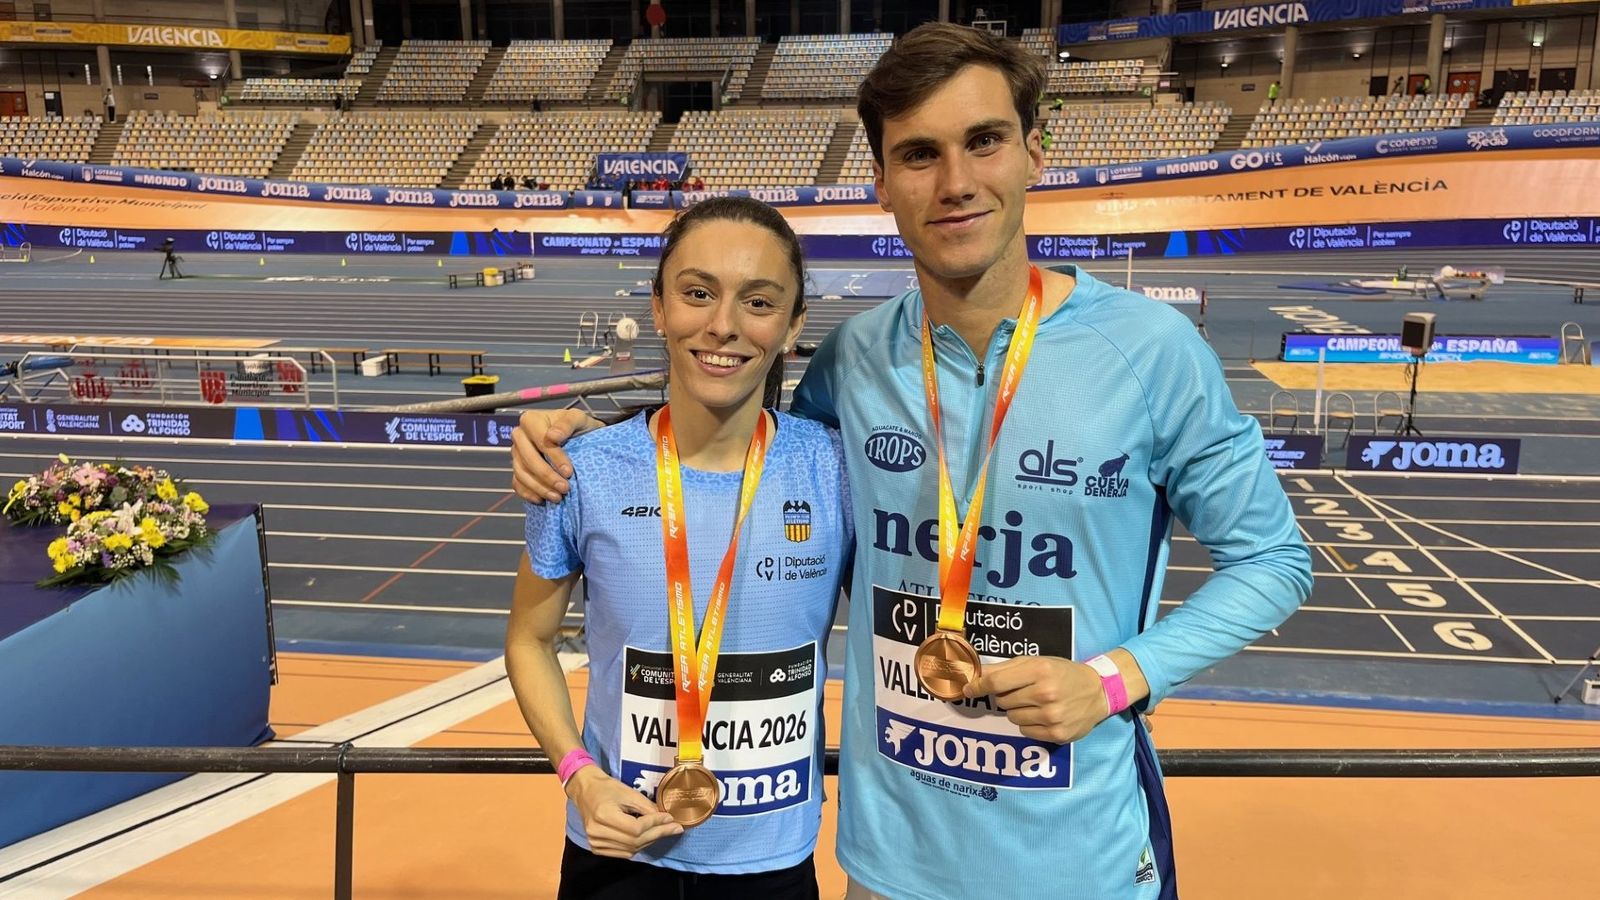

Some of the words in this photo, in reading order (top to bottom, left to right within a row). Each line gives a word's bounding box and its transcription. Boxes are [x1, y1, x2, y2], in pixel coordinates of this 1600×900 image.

[1213, 2, 1309, 30] VALENCIA
[127, 25, 224, 46] VALENCIA
[1304, 152, 1339, 164] Halcón
[604, 159, 680, 175] VALENCIA
[1166, 160, 1219, 174] MONDO
[143, 174, 188, 187] MONDO
[198, 177, 247, 193] Joma
[1294, 186, 1323, 197] DE
[1330, 177, 1449, 196] VALÈNCIA
[261, 182, 310, 198] Joma
[324, 186, 373, 202] Joma
[815, 186, 868, 202] Joma
[385, 189, 435, 205] Joma
[449, 192, 500, 208] Joma
[514, 193, 564, 208] Joma
[1531, 220, 1579, 232] Diputació
[77, 228, 107, 238] Diputació
[224, 231, 256, 241] Diputació
[364, 233, 395, 242] Diputació
[1314, 227, 1357, 239] Diputació
[1373, 231, 1385, 239] Per
[1530, 233, 1543, 242] de
[1545, 232, 1586, 242] València
[77, 238, 86, 247] de
[87, 238, 114, 248] València
[225, 241, 234, 250] de
[234, 241, 262, 250] València
[364, 243, 374, 251] de
[374, 243, 402, 252] València
[542, 236, 612, 248] CAMPEONATO
[1060, 237, 1098, 247] Diputació
[1313, 240, 1325, 248] de
[1326, 238, 1364, 248] València
[1059, 248, 1070, 256] de
[1072, 247, 1105, 256] València
[1327, 338, 1402, 352] CAMPEON
[1446, 337, 1519, 353] ESPAÑA
[56, 413, 99, 421] GENERALITAT
[147, 419, 190, 428] TRINIDAD
[57, 421, 99, 429] VALENCIANA
[147, 427, 190, 436] ALFONSO
[401, 423, 457, 433] COMUNITAT
[406, 432, 419, 441] DE
[420, 432, 464, 441] L'ESPORT
[867, 434, 923, 467] TROPS
[1392, 441, 1505, 470] Joma
[1018, 483, 1042, 491] sport
[1051, 487, 1073, 495] shop
[1085, 476, 1129, 489] CUEVA
[1287, 478, 1315, 491] 1
[1304, 498, 1349, 515] 2
[1325, 521, 1374, 541] 3
[873, 508, 1078, 588] nerja
[785, 556, 826, 568] Diputació
[1363, 551, 1413, 573] 4
[785, 570, 797, 580] de
[800, 568, 827, 580] València
[1386, 582, 1447, 608] 5
[935, 603, 1023, 631] utació
[1433, 622, 1493, 651] 6
[641, 669, 674, 678] COMUNIT
[787, 670, 812, 682] ALFONSO
[788, 664, 812, 676] TRINIDAD
[655, 677, 674, 685] L'ESP
[631, 713, 754, 750] VALNCIA
[758, 710, 807, 748] 2026
[914, 727, 1056, 779] Joma
[910, 769, 936, 783] aguas
[938, 778, 951, 788] de
[718, 769, 801, 807] ma
